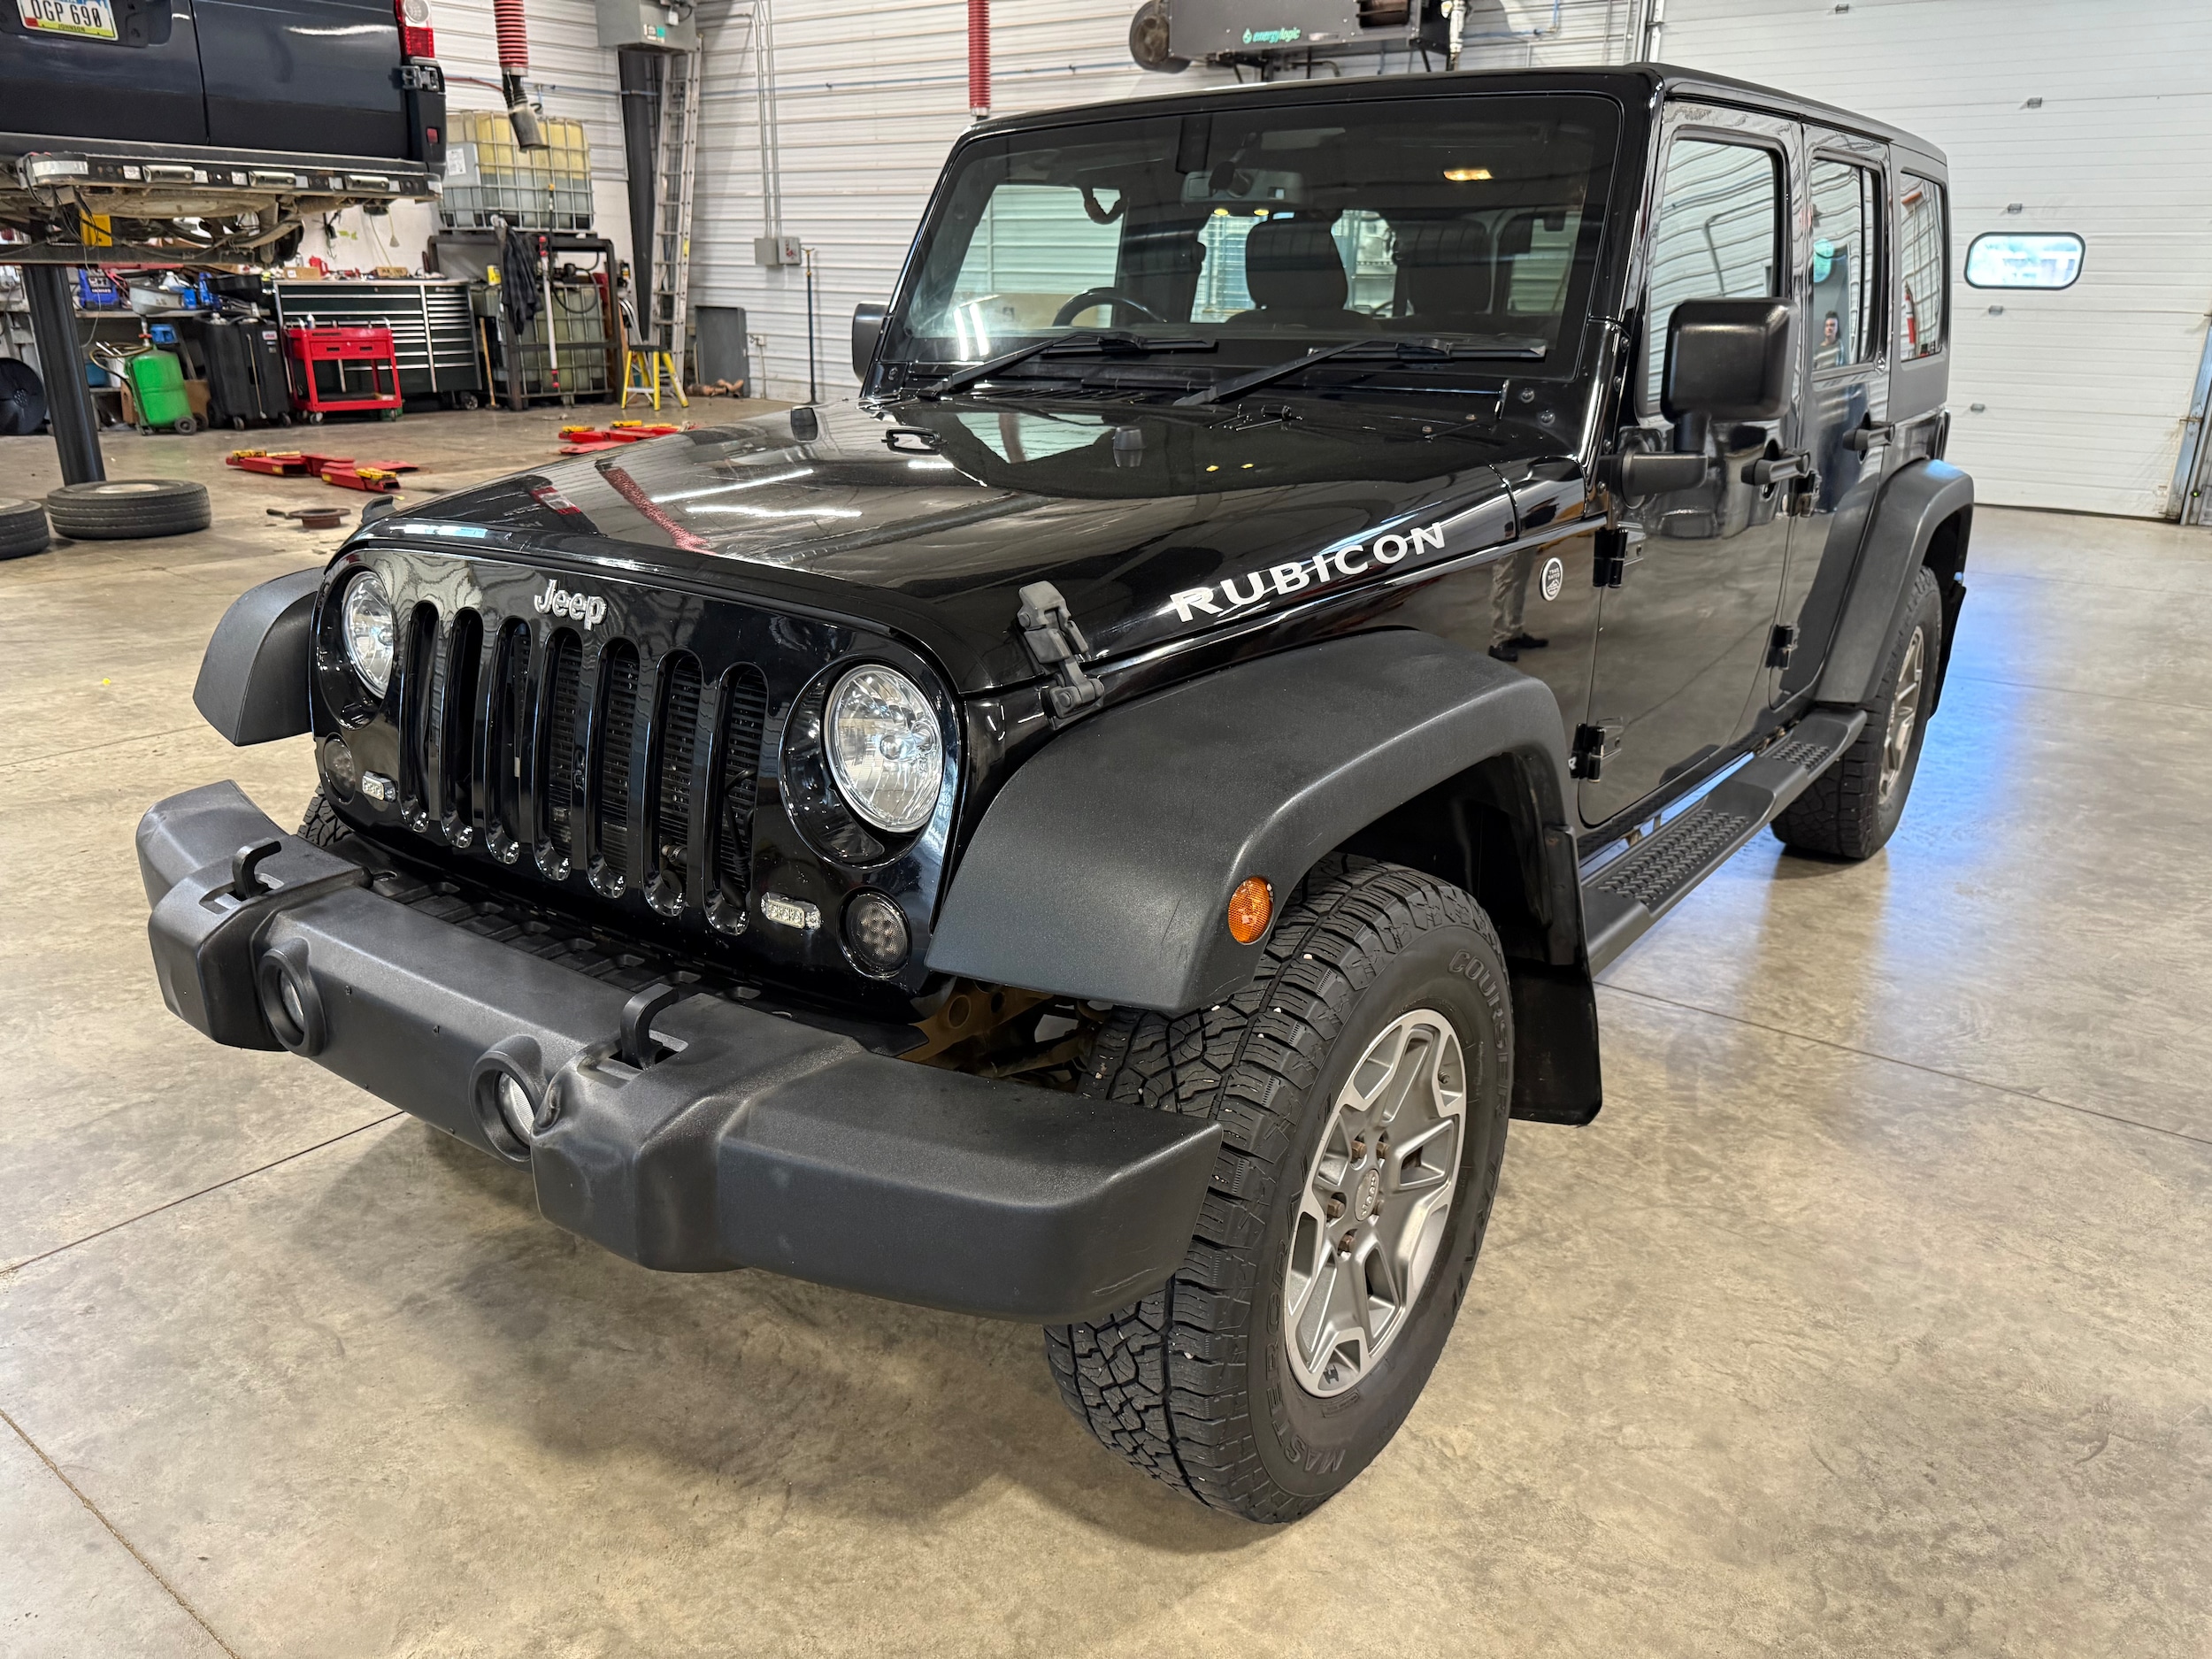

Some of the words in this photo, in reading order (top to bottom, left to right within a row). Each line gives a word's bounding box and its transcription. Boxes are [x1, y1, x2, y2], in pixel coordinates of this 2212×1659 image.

[70, 4, 102, 27] 690
[534, 579, 607, 631] Jeep
[1170, 521, 1446, 623] RUBICON
[1448, 949, 1508, 1118] COURSER
